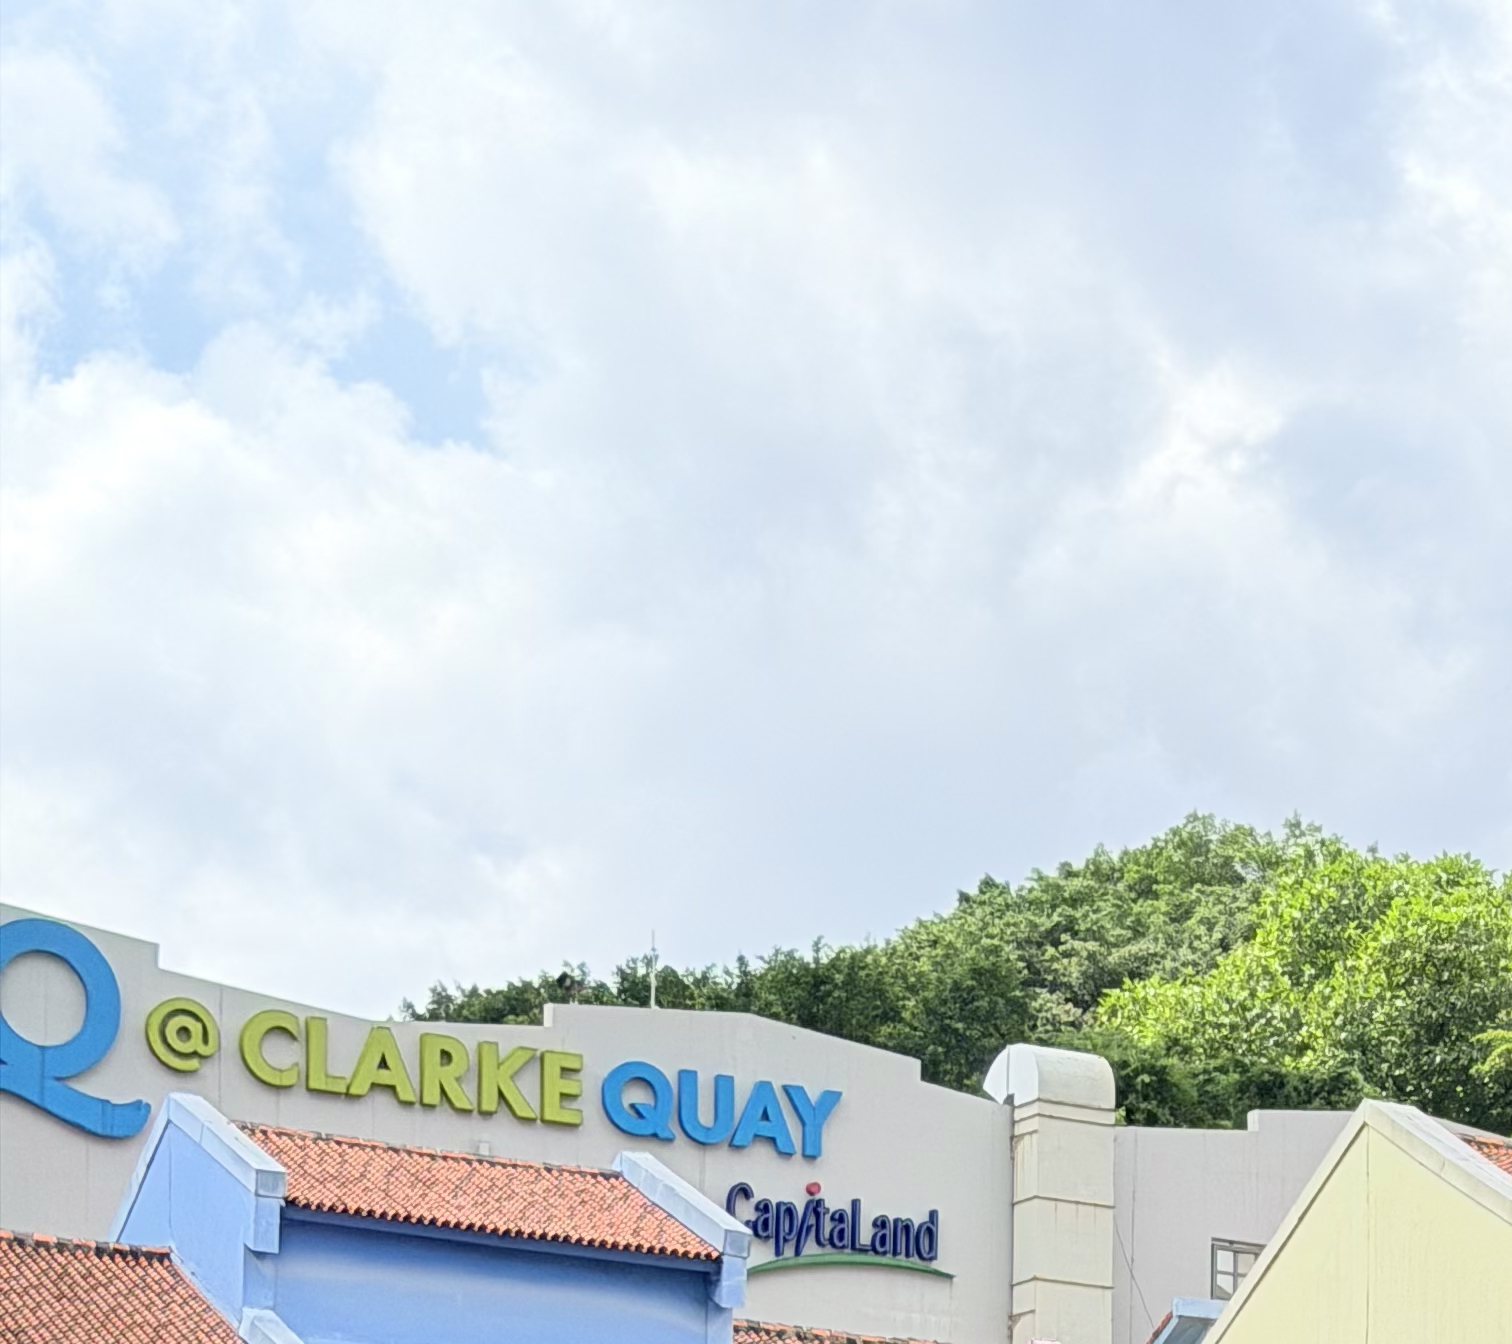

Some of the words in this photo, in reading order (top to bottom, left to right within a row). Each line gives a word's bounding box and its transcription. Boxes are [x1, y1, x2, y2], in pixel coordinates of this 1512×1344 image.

[144, 997, 220, 1073] @
[239, 1009, 584, 1127] CLARKE
[601, 1061, 843, 1159] QUAY
[725, 1182, 940, 1261] CapitaLand
